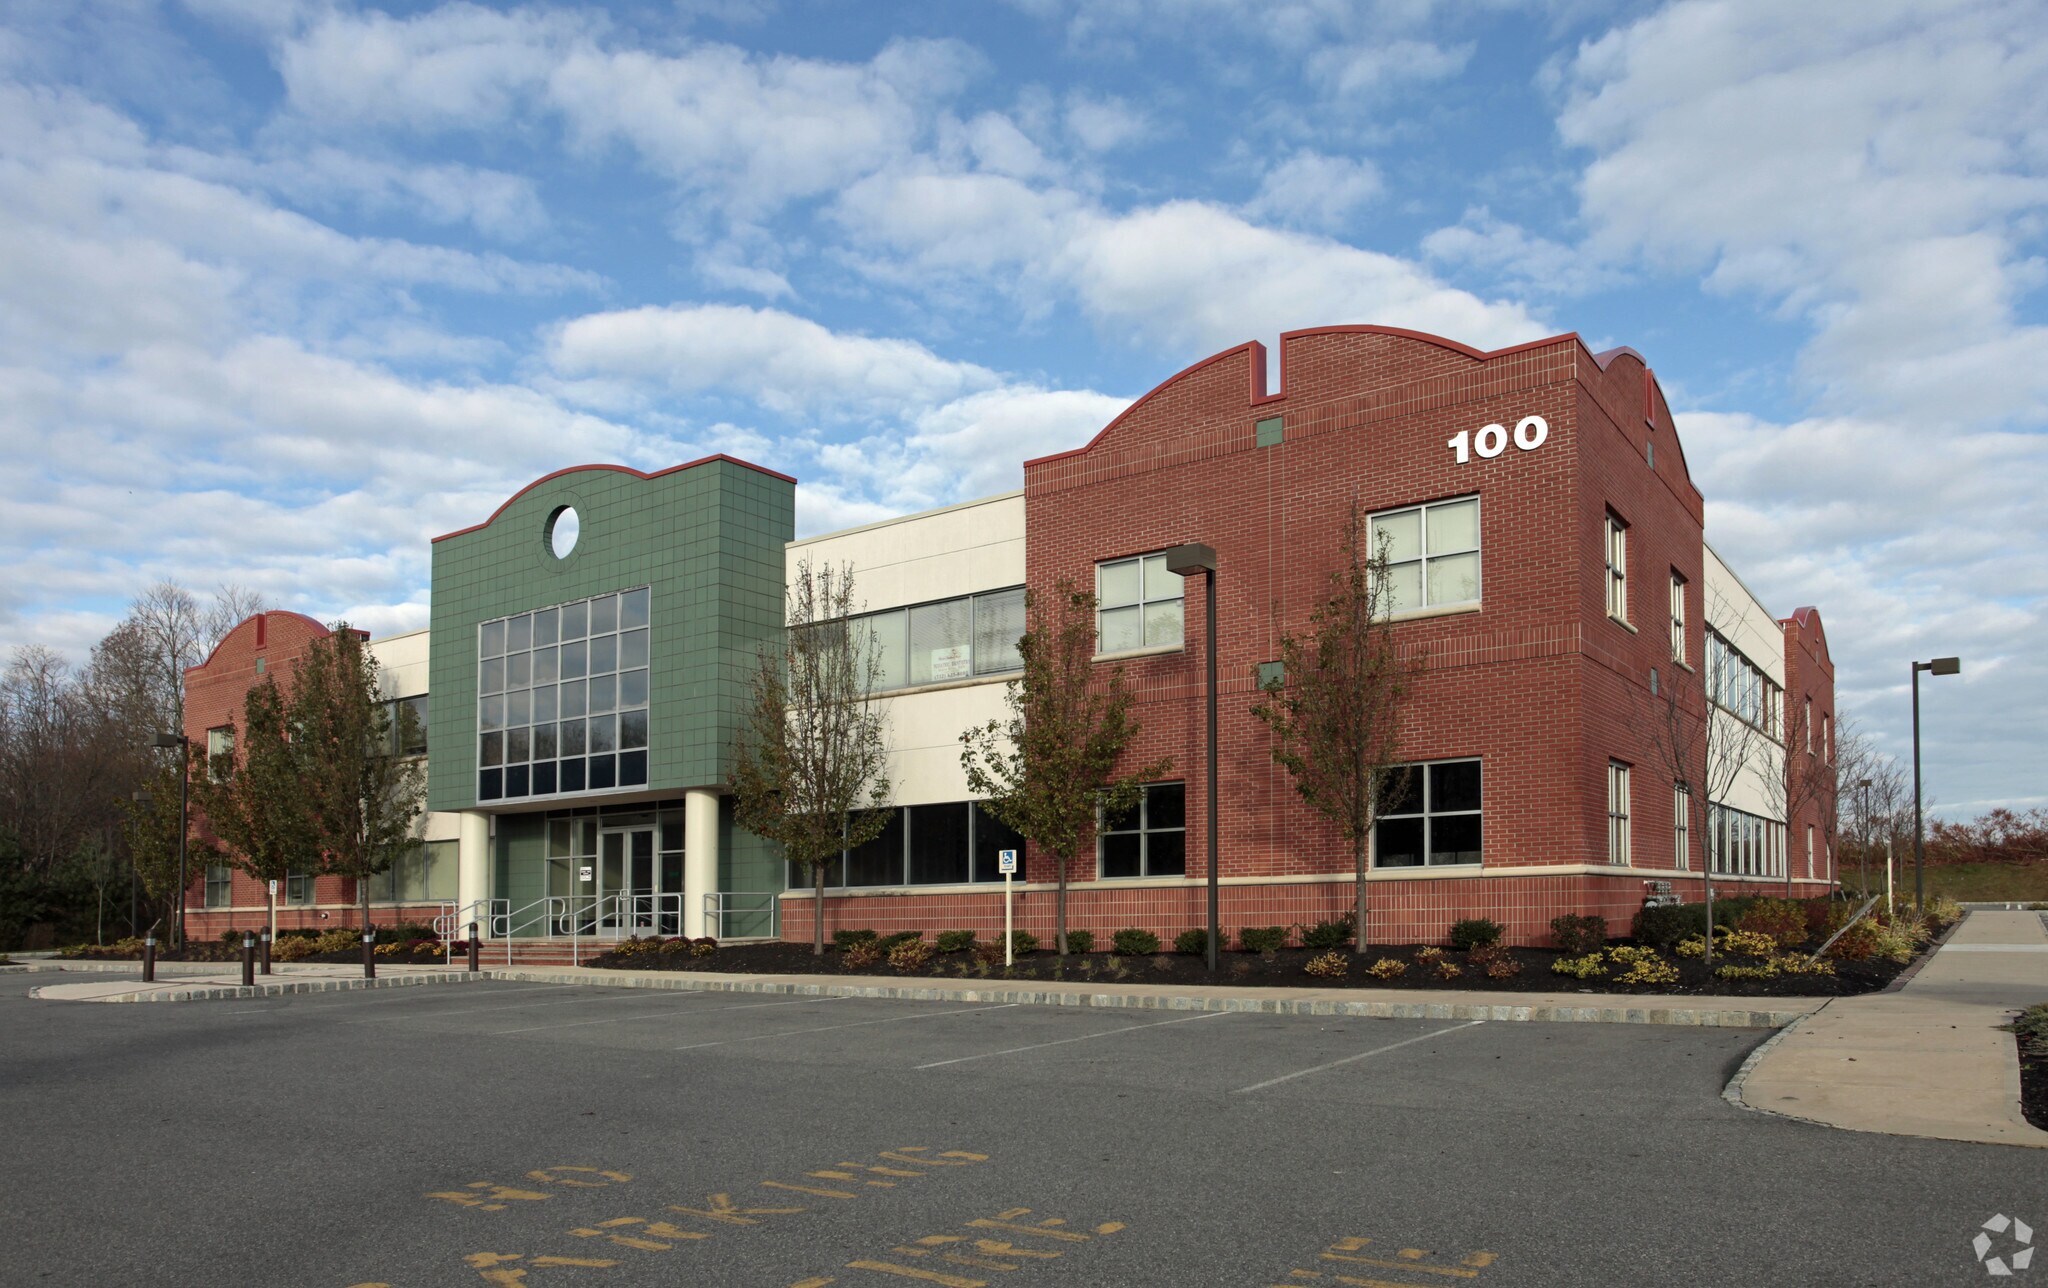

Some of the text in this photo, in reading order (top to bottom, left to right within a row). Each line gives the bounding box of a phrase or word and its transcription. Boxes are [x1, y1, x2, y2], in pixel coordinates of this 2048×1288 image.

[1447, 415, 1549, 464] 100
[424, 1165, 633, 1211] NO
[345, 1147, 991, 1288] ARKING
